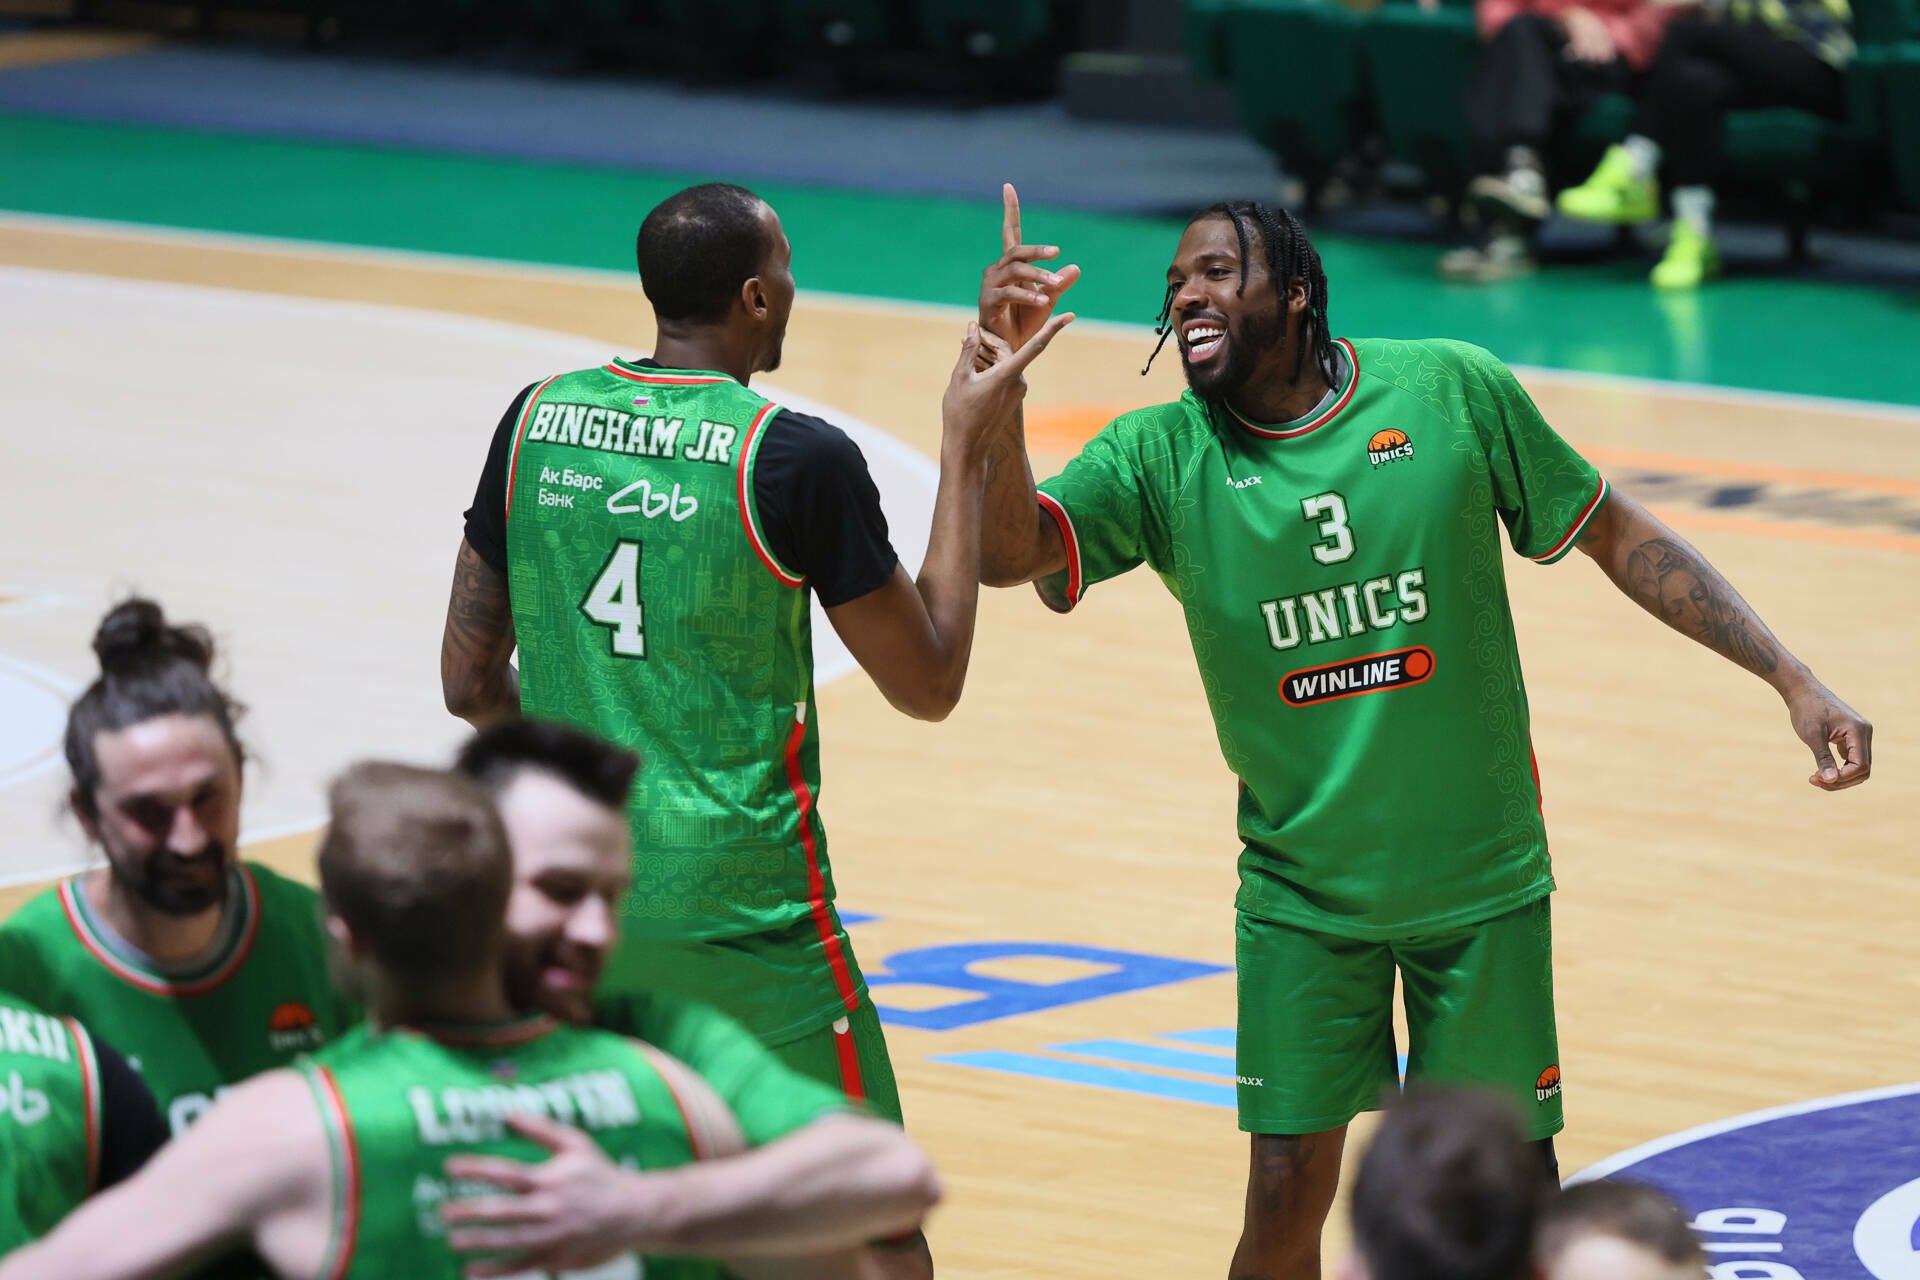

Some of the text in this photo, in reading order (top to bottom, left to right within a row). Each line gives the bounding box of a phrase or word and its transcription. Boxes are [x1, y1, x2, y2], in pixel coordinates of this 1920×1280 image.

[528, 402, 738, 464] BINGHAM JR
[1369, 442, 1414, 465] UNICS
[538, 488, 574, 509] Банк
[539, 466, 603, 491] Ак Барс
[1300, 490, 1357, 566] 3
[577, 537, 648, 661] 4
[1259, 567, 1430, 650] UNICS
[1292, 659, 1401, 699] WINLINE
